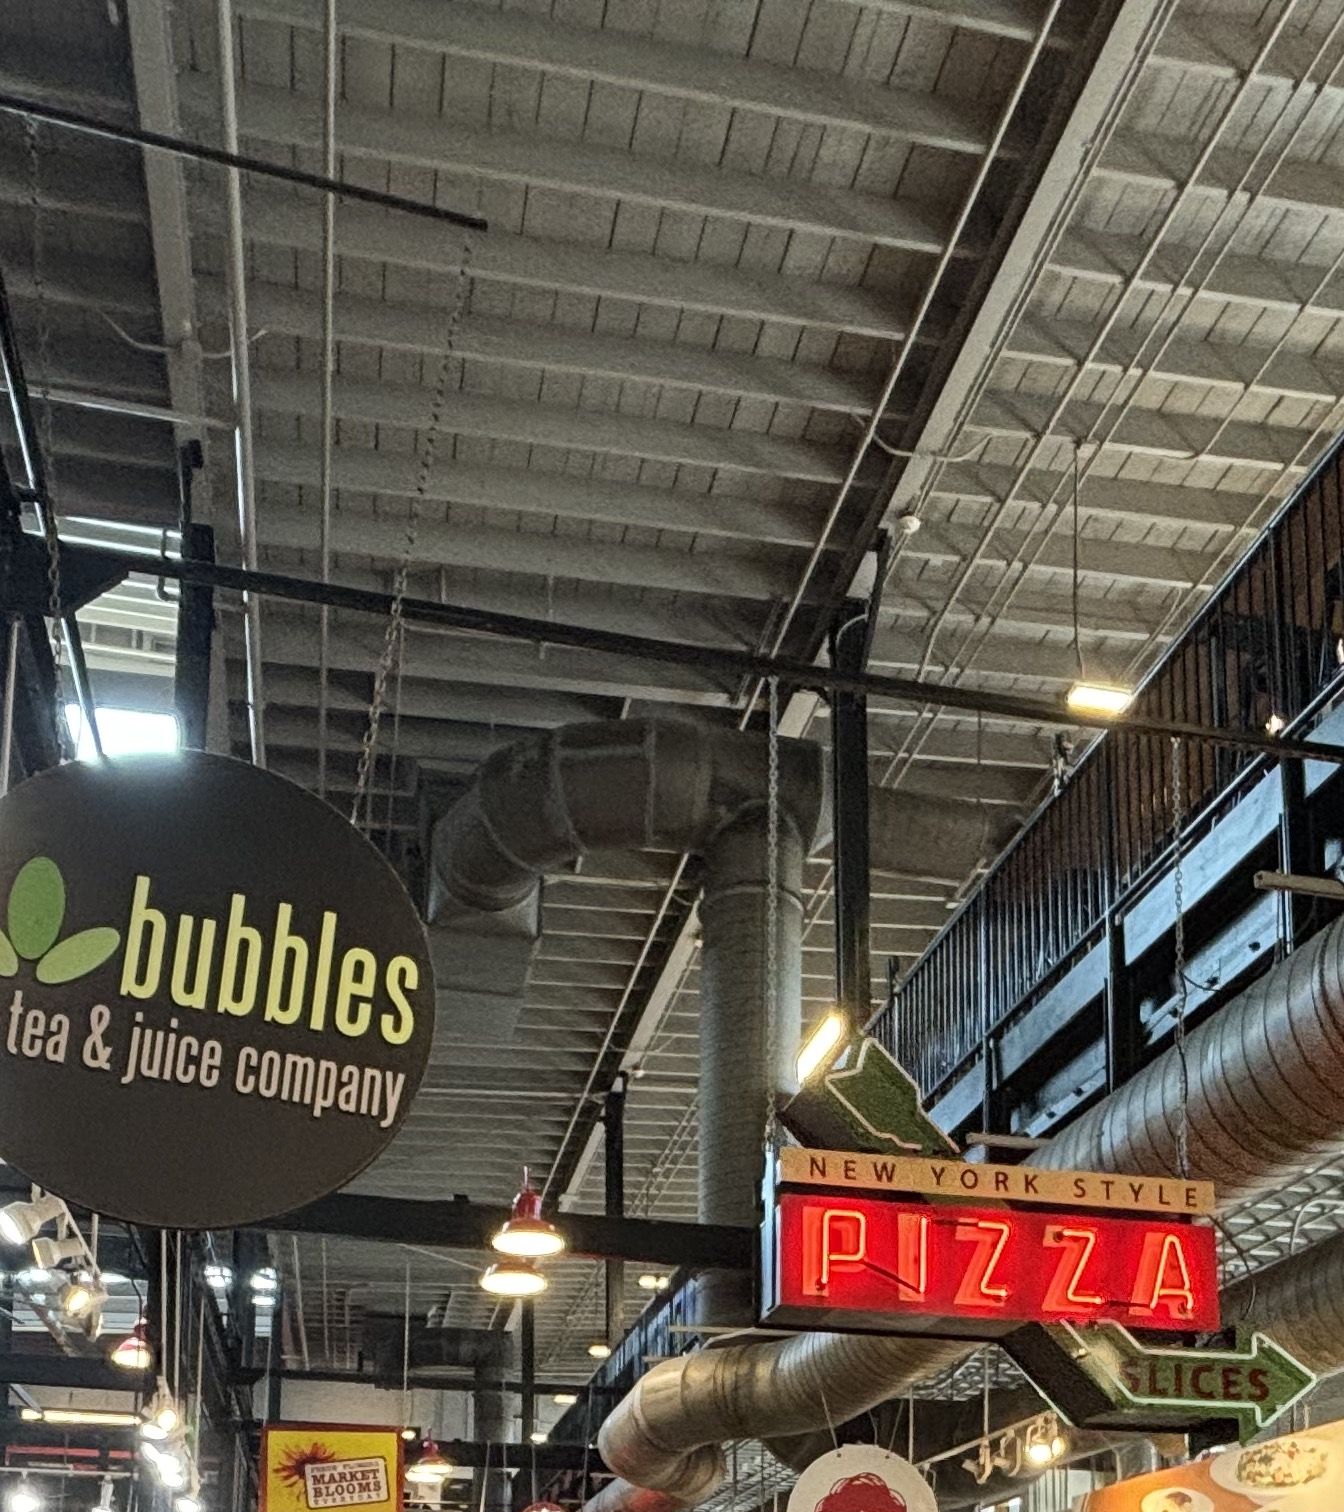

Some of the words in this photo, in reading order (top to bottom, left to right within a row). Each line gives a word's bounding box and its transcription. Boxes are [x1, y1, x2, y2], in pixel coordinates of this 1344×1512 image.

[120, 875, 418, 1045] bubbles
[7, 990, 68, 1062] tea
[82, 1004, 112, 1070] &
[121, 1012, 223, 1087] juice
[236, 1045, 406, 1128] company
[809, 1156, 897, 1182] NEW
[931, 1165, 1041, 1195] YORK
[1073, 1178, 1197, 1208] STYLE
[802, 1207, 1194, 1316] PIZZA
[1123, 1357, 1271, 1402] SLICES
[311, 1468, 379, 1485] MARKET
[313, 1480, 381, 1498] BLOOMS
